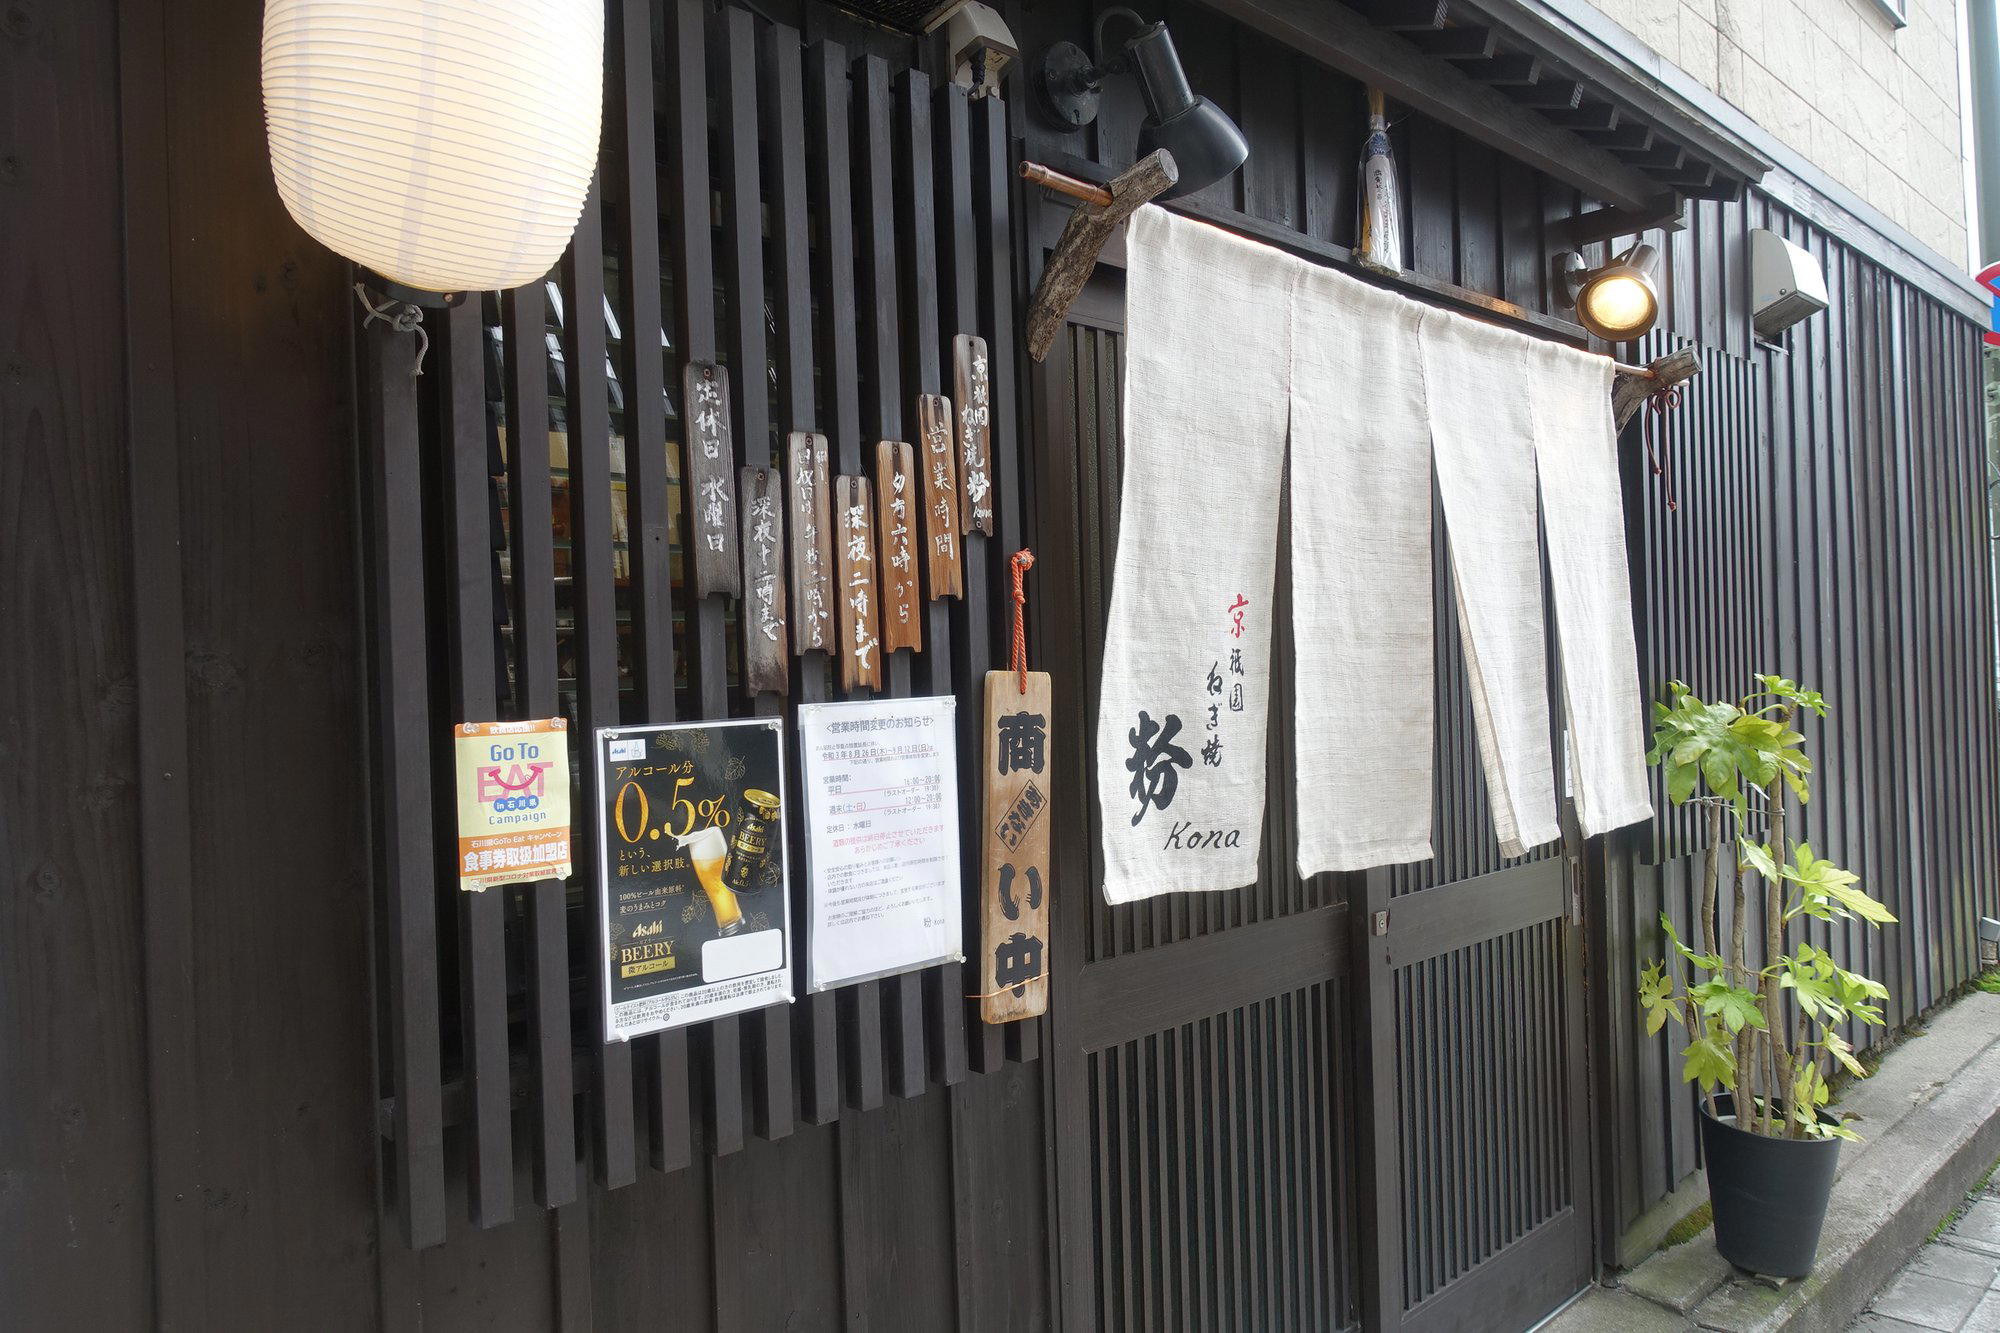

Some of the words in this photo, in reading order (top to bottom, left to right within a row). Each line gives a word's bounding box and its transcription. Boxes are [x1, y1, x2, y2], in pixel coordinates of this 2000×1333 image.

[927, 421, 954, 560] 営業時間
[701, 474, 729, 552] 水曜日
[890, 471, 913, 624] 夕方六時から
[751, 496, 785, 641] 深夜十二時まで
[845, 504, 879, 670] 深夜二時まで
[1201, 661, 1223, 768] ねぎ焼
[490, 744, 515, 762] Go
[517, 742, 539, 759] To
[477, 761, 553, 803] EAT
[615, 760, 694, 780] アルコール分
[1125, 710, 1193, 827] 粉
[828, 785, 842, 796] 平日
[489, 811, 547, 825] Campaign
[615, 776, 731, 843] 0.5%
[1164, 821, 1241, 851] Kona
[463, 840, 568, 873] 食事券取扱加盟店
[618, 857, 691, 877] 新しい選択肢。
[620, 847, 651, 861] という、
[620, 900, 667, 914] 麦のうまみとコク
[632, 920, 663, 938] Asahi
[621, 940, 674, 964] BEERY
[628, 960, 669, 975] 微アルコール
